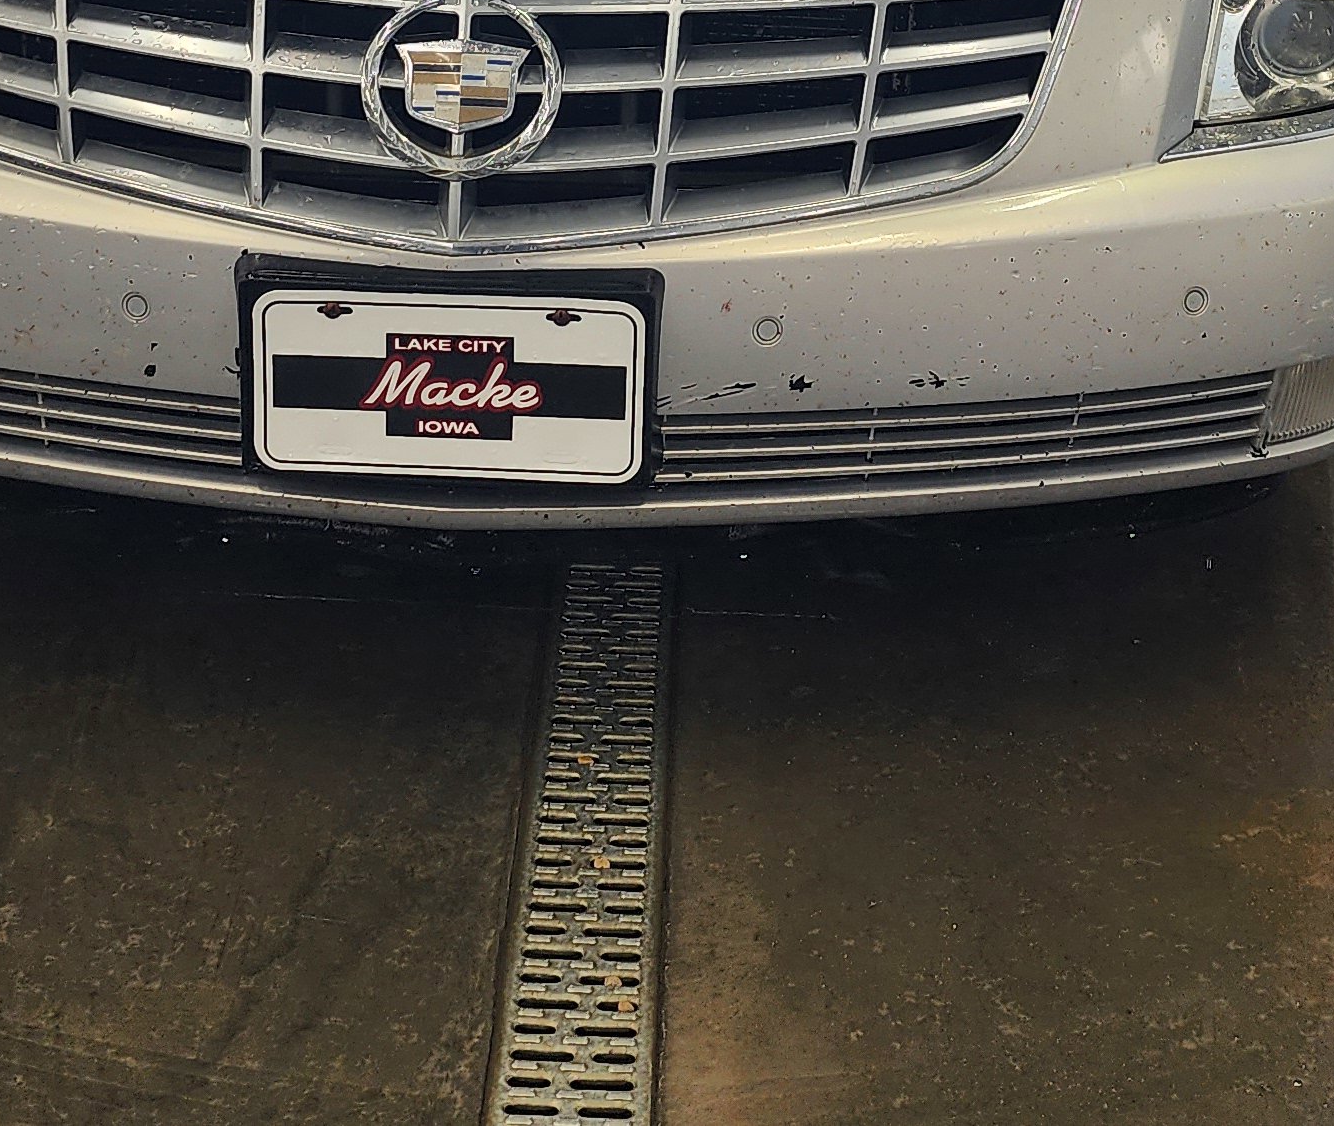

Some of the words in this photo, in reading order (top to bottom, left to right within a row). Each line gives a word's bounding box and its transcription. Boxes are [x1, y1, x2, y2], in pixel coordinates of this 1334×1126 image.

[394, 337, 452, 352] LAKE
[458, 339, 506, 354] CITY
[362, 359, 541, 410] Macke
[418, 420, 480, 435] IOWA
